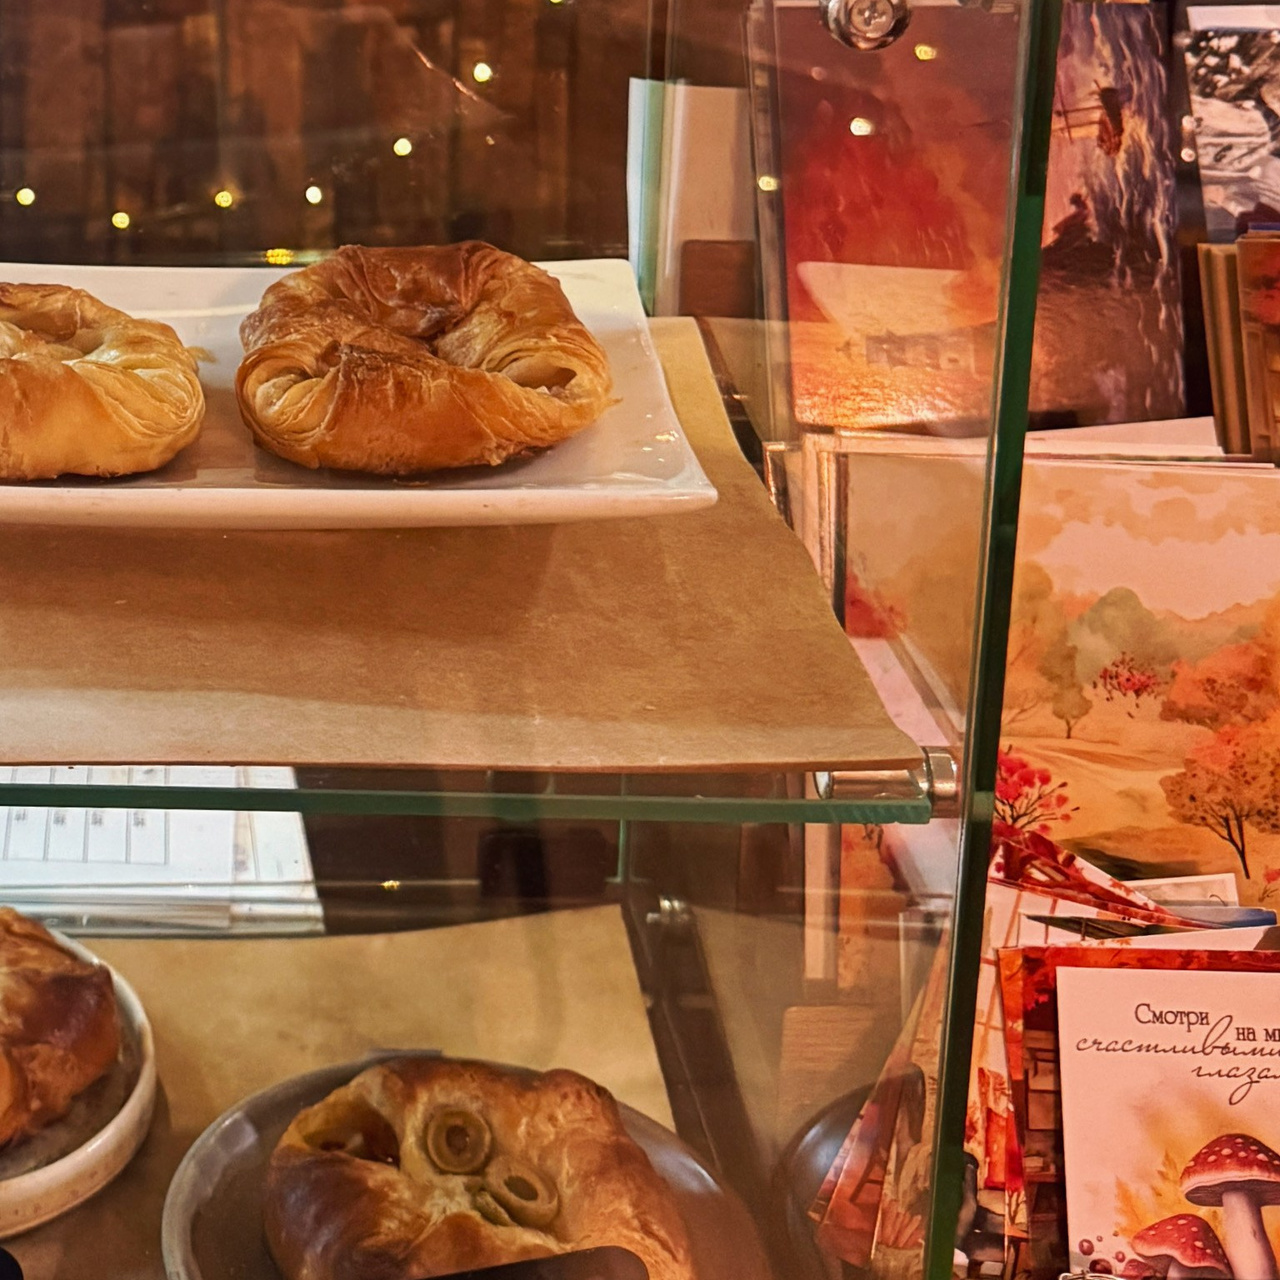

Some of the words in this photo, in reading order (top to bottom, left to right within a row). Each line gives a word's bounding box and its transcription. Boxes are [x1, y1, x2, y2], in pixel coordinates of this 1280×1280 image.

[1135, 1003, 1210, 1032] Смотри
[1235, 1027, 1257, 1042] на
[1263, 1028, 1280, 1042] м
[1192, 1066, 1280, 1106] глаза
